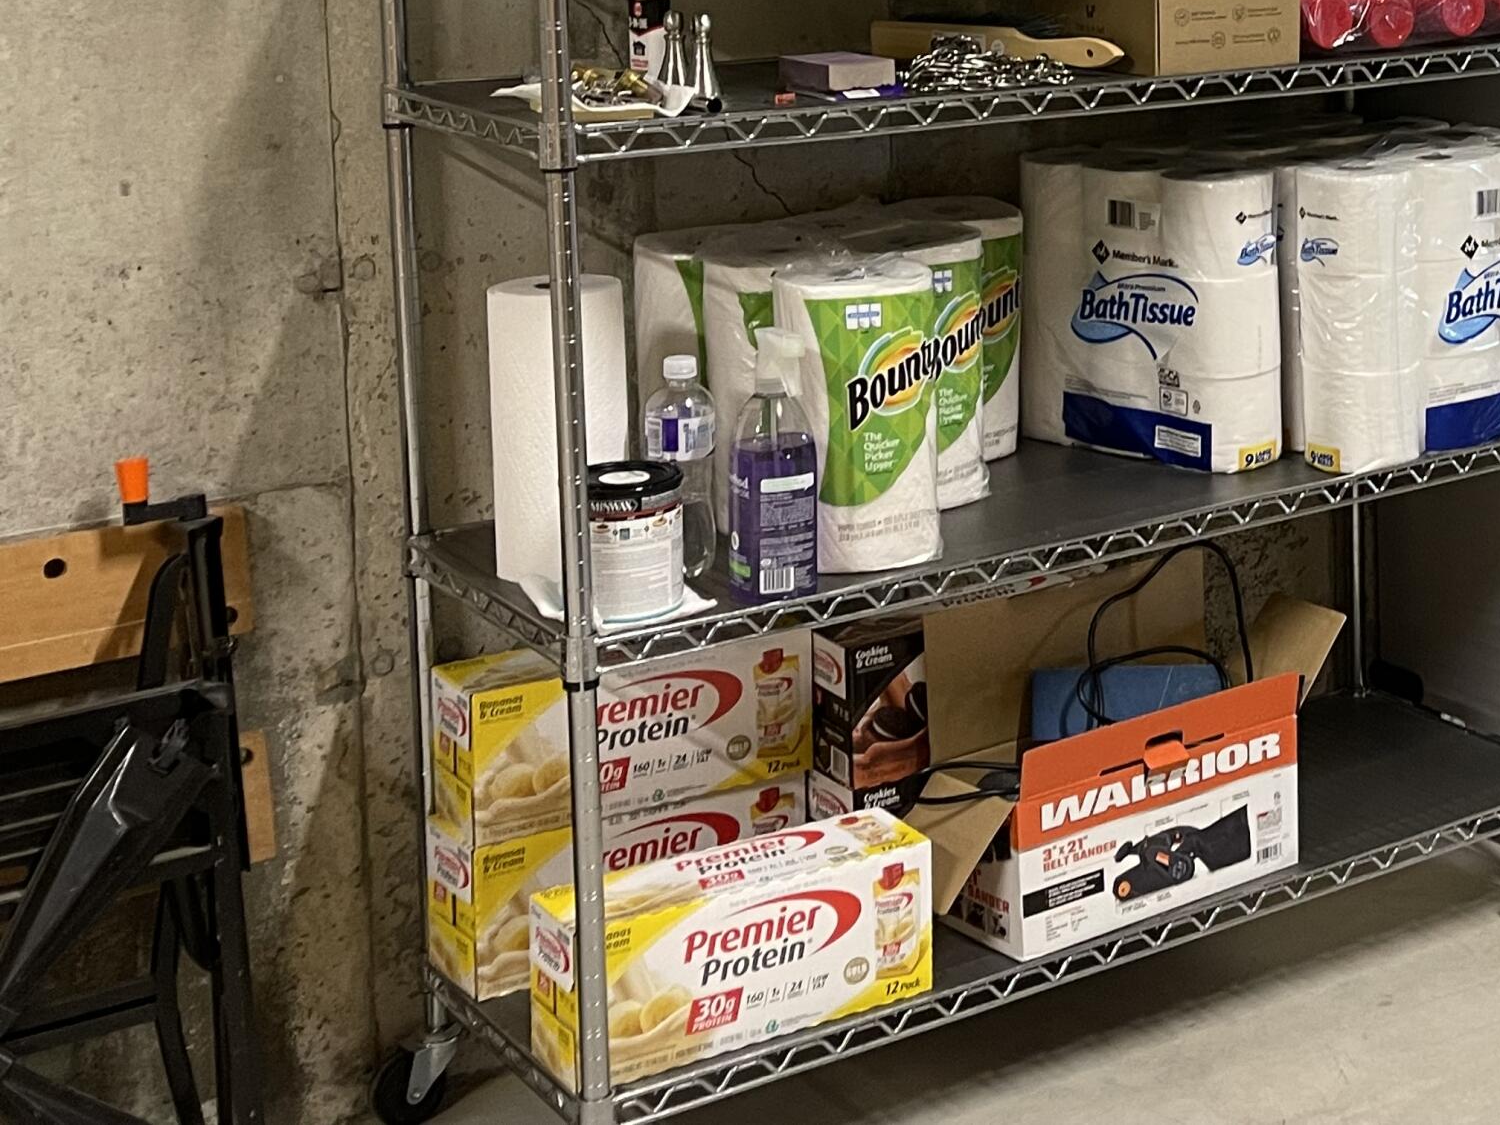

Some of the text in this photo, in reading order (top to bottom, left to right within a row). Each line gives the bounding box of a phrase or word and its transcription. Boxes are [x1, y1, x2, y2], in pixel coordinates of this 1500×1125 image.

[1112, 249, 1175, 268] Member's Mark
[847, 338, 940, 431] Bounty
[864, 431, 900, 453] The Quicker
[864, 449, 897, 462] Picker
[1245, 453, 1254, 467] 9
[855, 644, 889, 660] Cookies
[864, 654, 893, 667] Cream
[479, 694, 524, 710] Bananas
[489, 704, 523, 719] Cream
[597, 682, 705, 726] remier
[600, 763, 625, 786] 0g
[633, 762, 651, 773] 160
[767, 759, 801, 773] 12 Pack
[864, 786, 897, 804] Cookies
[602, 826, 703, 873] remier
[1067, 834, 1089, 853] 21"
[675, 835, 789, 872] Premier
[698, 848, 787, 876] Protein
[1043, 840, 1118, 873] BELT SANDER
[606, 927, 632, 941] anas
[682, 904, 823, 965] Premier
[606, 938, 631, 950] eam
[700, 937, 806, 987] Protein
[885, 979, 921, 996] 12 Pack
[698, 996, 736, 1022] 30g
[746, 992, 764, 1005] 160
[790, 980, 804, 993] 24
[692, 1013, 735, 1032] PROTEIN
